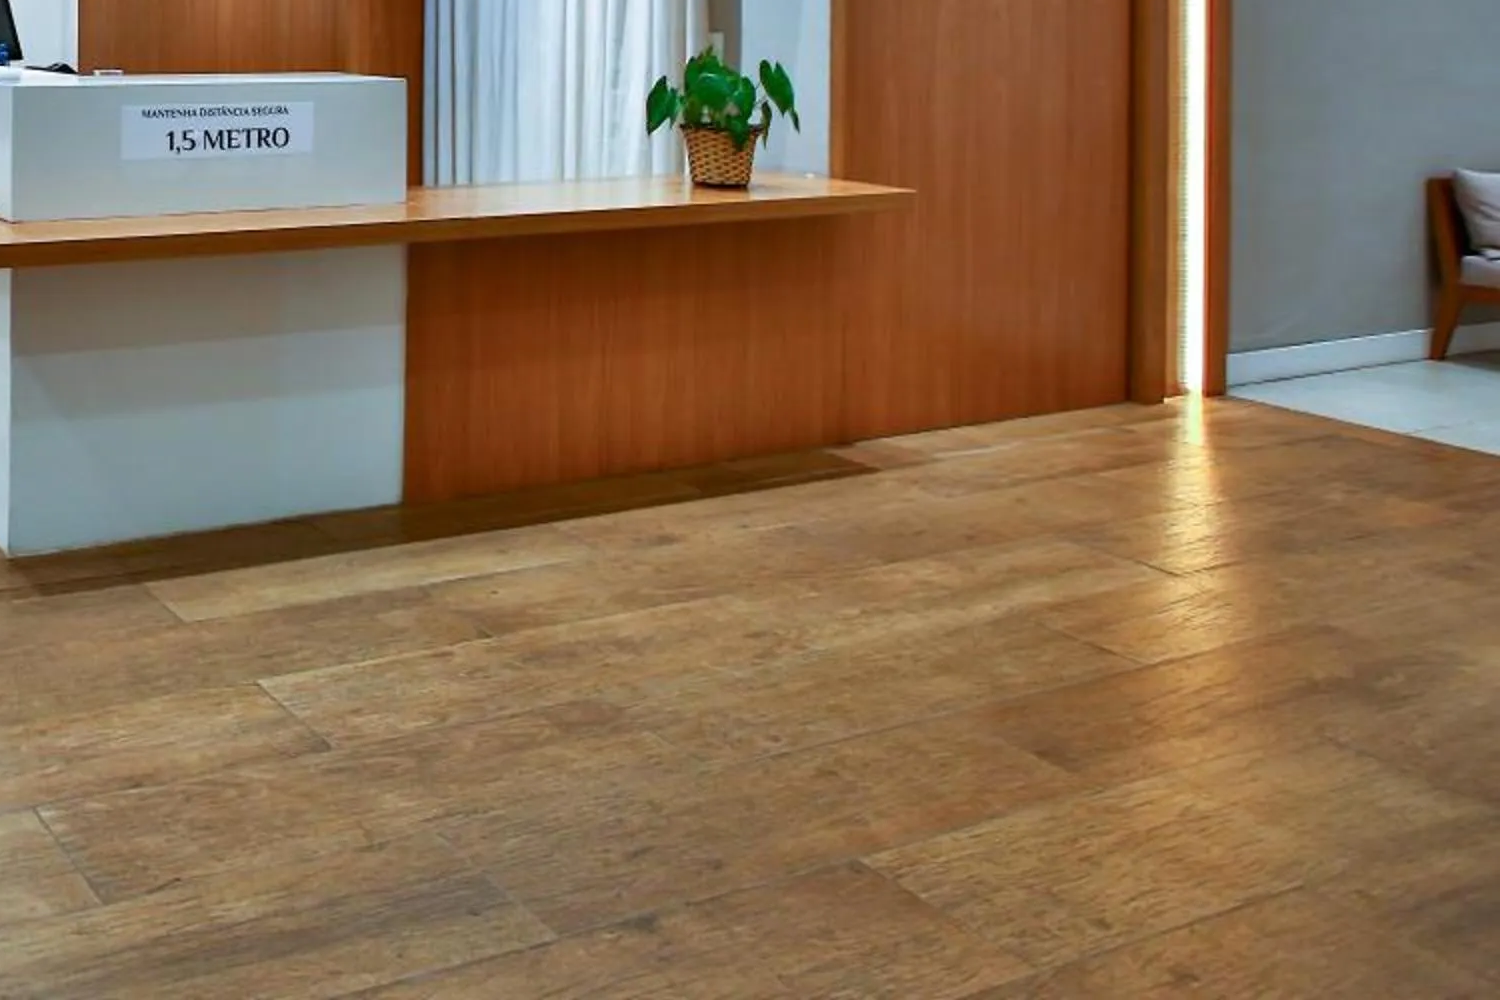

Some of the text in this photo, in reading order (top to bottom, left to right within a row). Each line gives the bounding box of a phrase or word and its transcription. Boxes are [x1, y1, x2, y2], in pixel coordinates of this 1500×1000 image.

[141, 105, 289, 118] MANTENHA DISTÂNCIA SEGURA
[166, 127, 291, 154] 1,5 METRO
